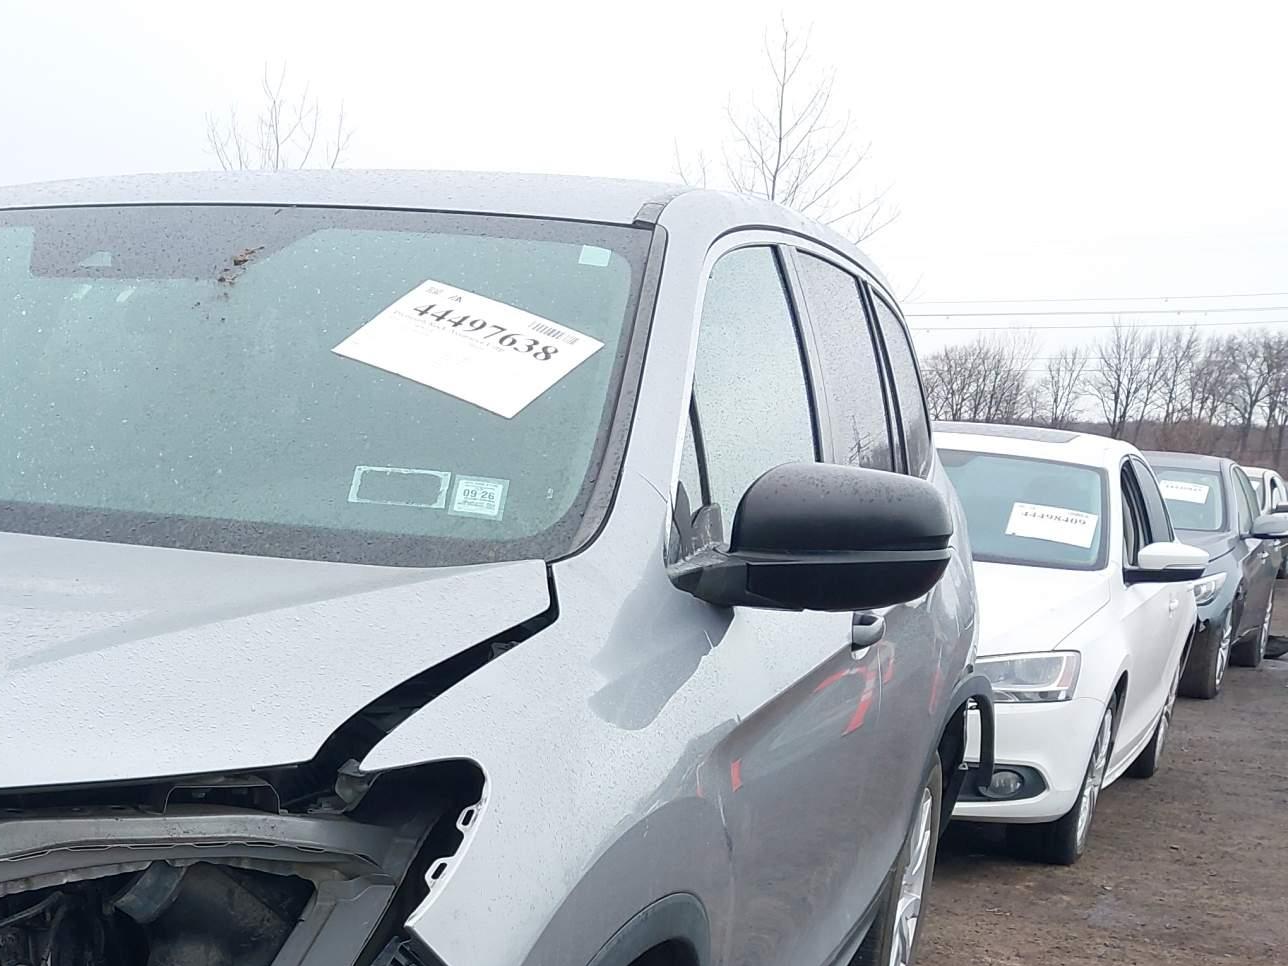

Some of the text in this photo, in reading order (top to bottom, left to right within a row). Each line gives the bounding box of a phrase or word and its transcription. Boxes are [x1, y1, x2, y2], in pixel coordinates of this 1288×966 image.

[413, 303, 559, 361] 44497638
[463, 488, 495, 500] 09 26
